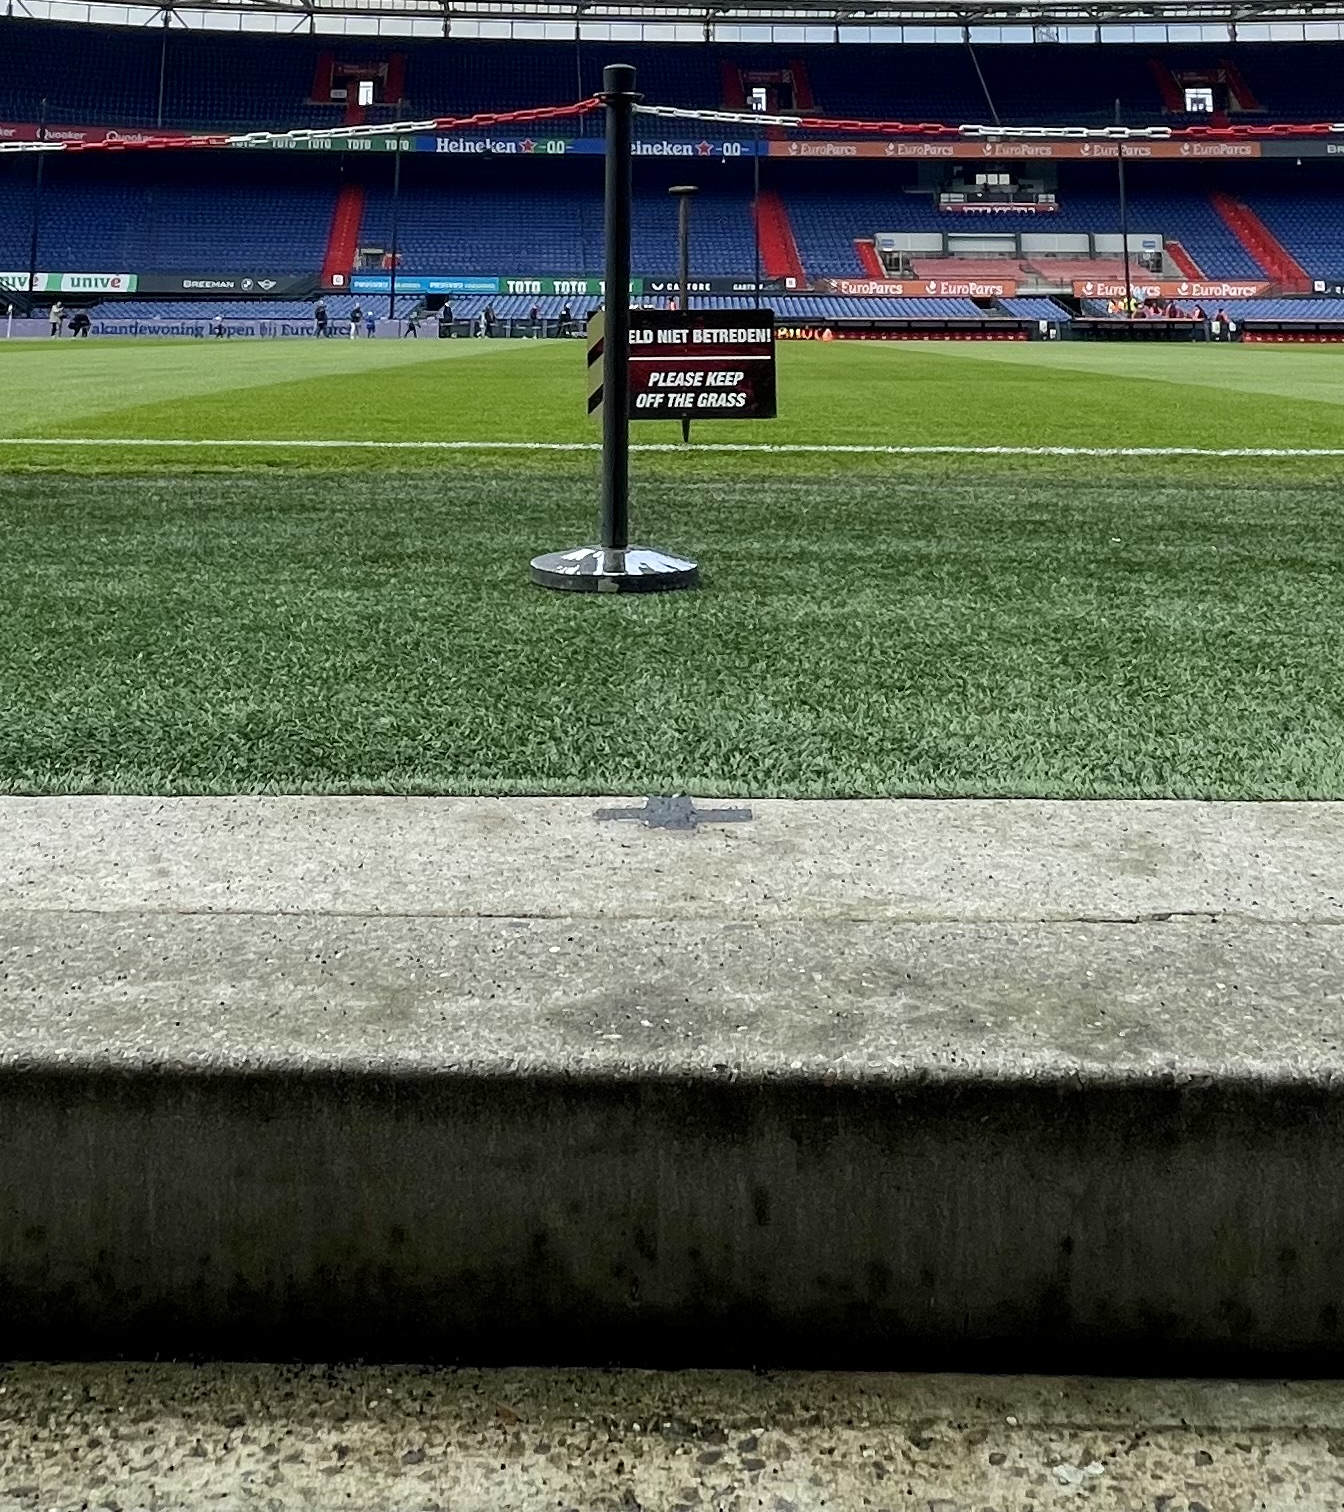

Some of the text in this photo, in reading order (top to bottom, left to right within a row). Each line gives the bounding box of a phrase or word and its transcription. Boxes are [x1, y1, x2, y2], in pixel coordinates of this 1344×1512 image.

[436, 137, 517, 153] Heineken
[631, 139, 693, 156] eineken
[800, 144, 856, 155] EuroParcs
[897, 144, 954, 156] EuroParcs
[995, 144, 1052, 156] EuroParcs
[1193, 144, 1251, 155] EuroParcs
[508, 281, 541, 294] TOTO
[553, 281, 587, 294] TOTO
[841, 281, 903, 295] EuroParcs
[941, 281, 1003, 295] EuroParcs
[1192, 283, 1257, 296] EuroParcs
[91, 320, 205, 338] akantiewoning
[629, 329, 654, 344] ELD
[657, 329, 689, 344] NIET
[693, 329, 771, 343] BETREDEN!
[648, 372, 744, 387] PLEASE KEEP
[636, 393, 747, 408] OFF THE GRASS
